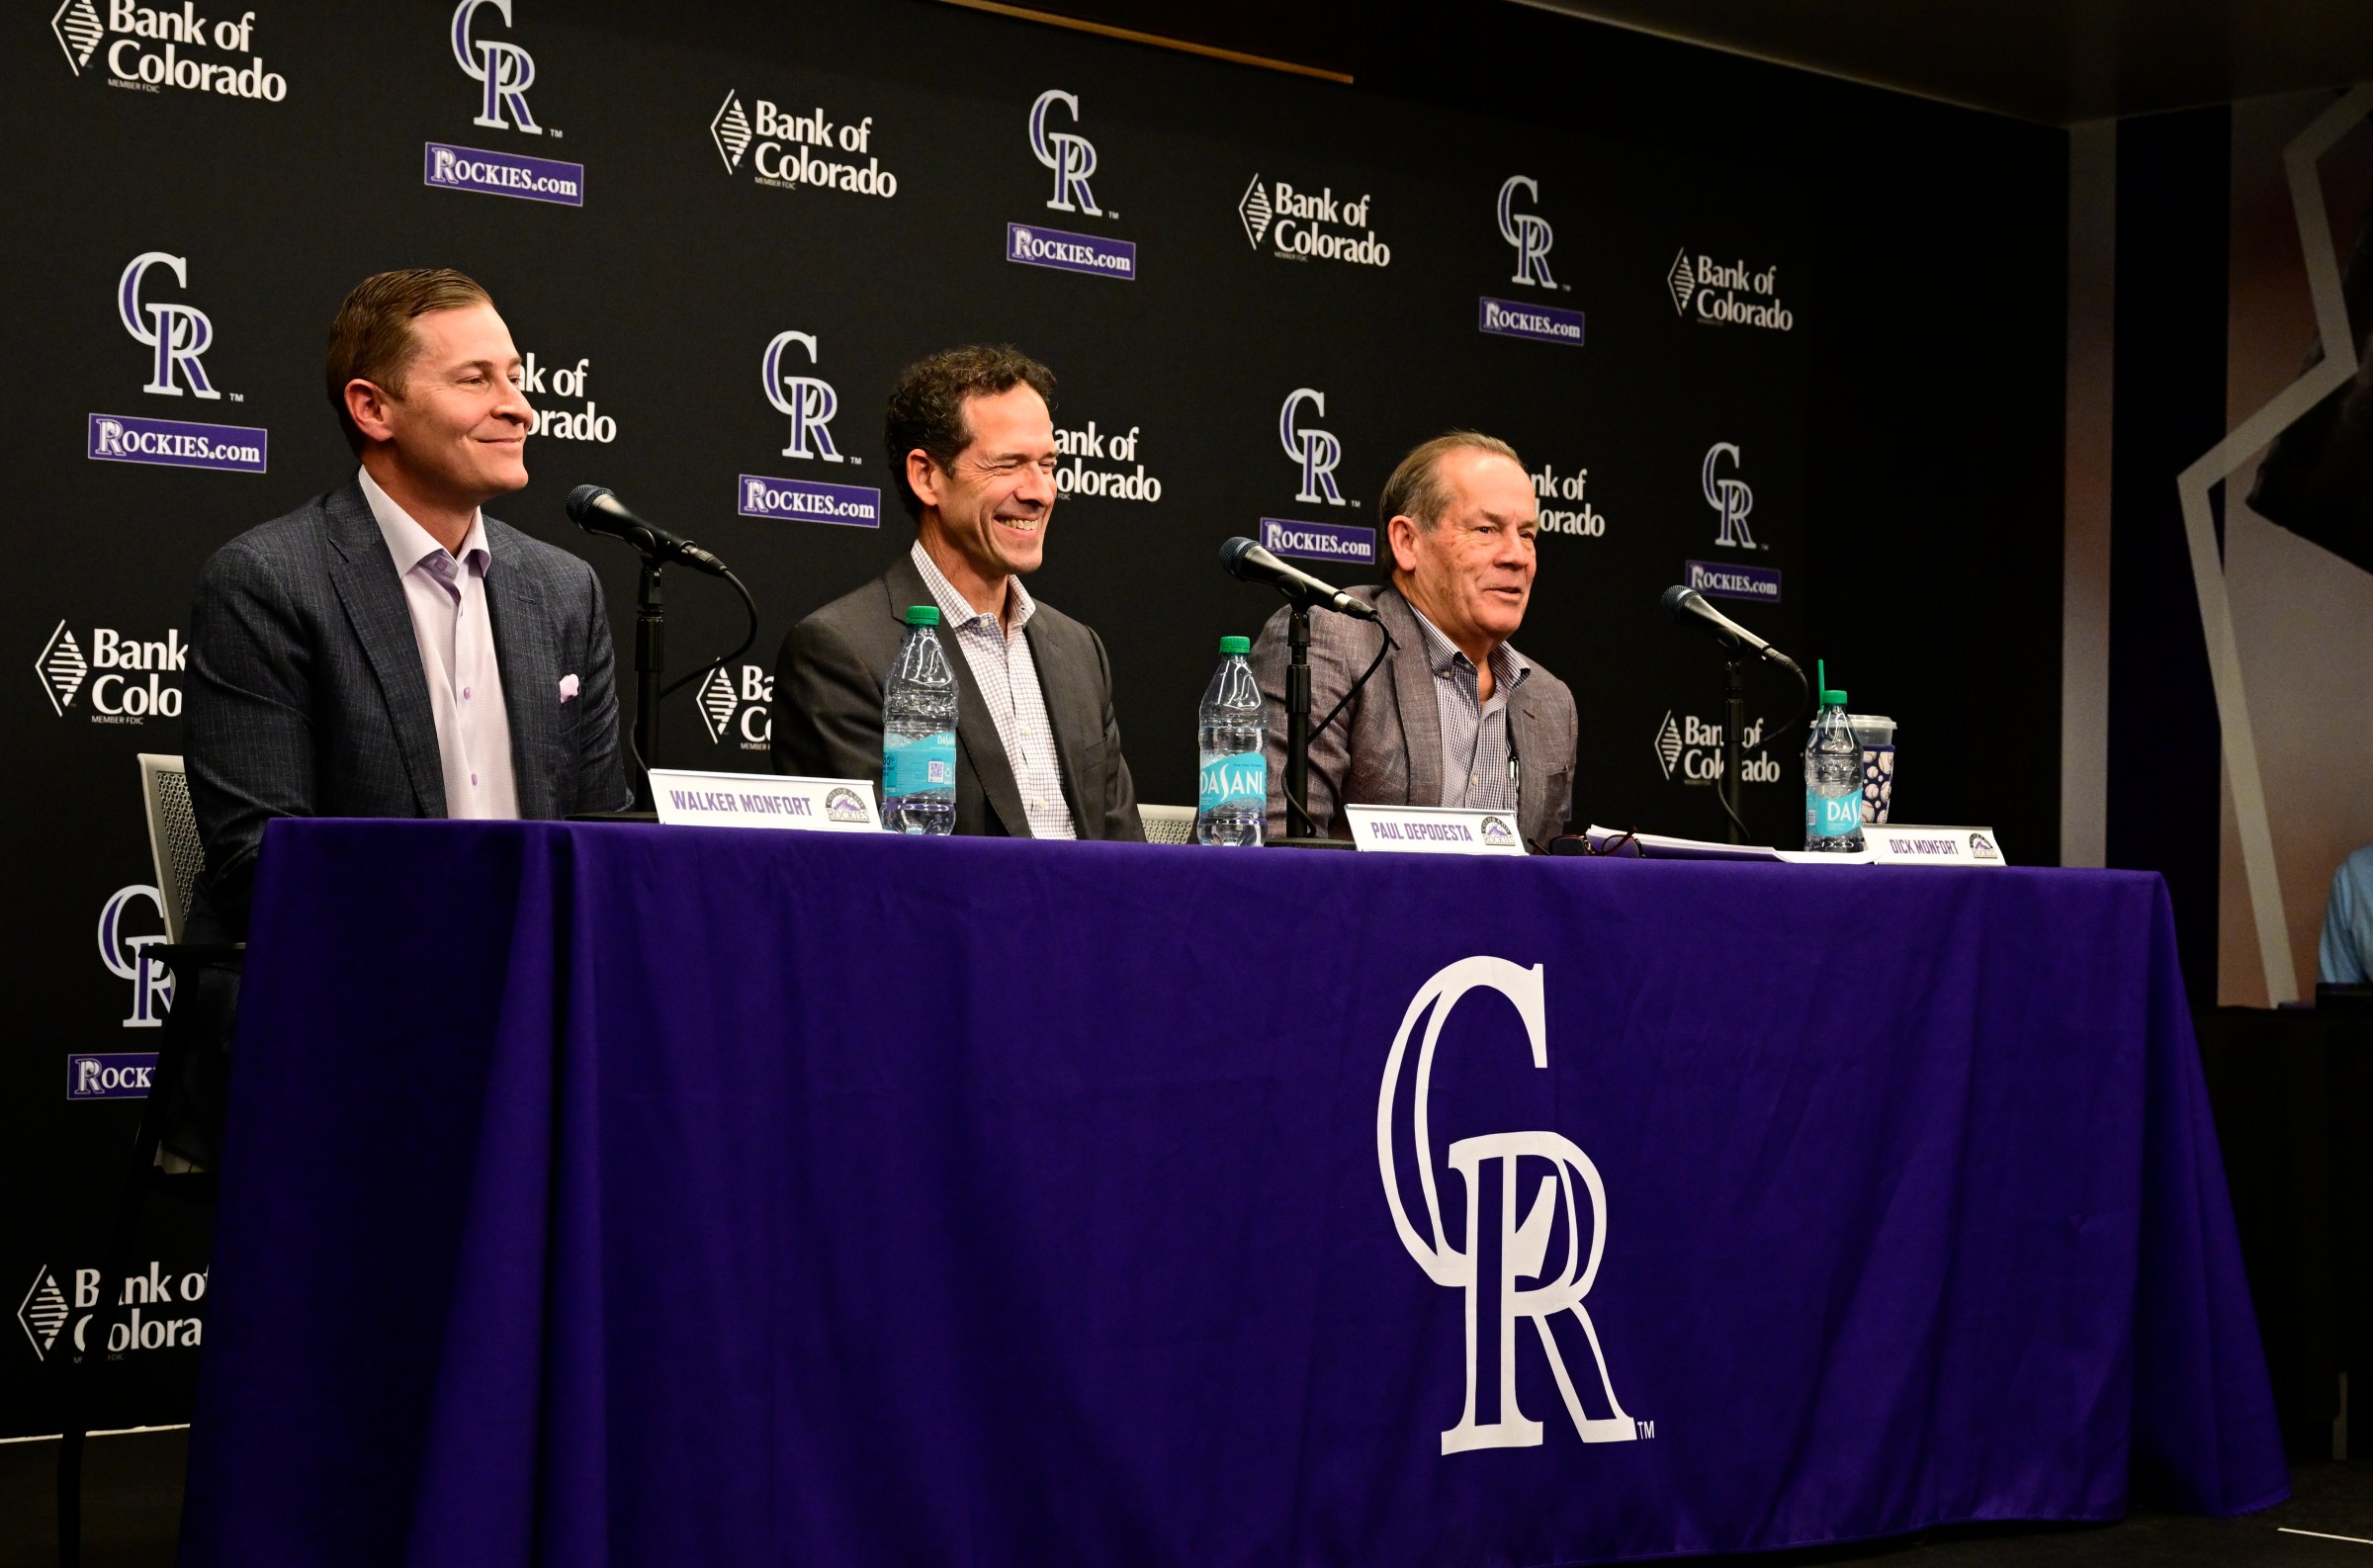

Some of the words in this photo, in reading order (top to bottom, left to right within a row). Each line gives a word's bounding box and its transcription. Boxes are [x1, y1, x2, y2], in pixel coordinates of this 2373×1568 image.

[110, 0, 207, 45] Bank
[214, 12, 256, 52] of
[108, 40, 287, 102] Colorado
[108, 78, 141, 91] MEMBER
[141, 82, 160, 94] FDIC
[755, 100, 834, 147] Bank
[838, 117, 872, 153] of
[754, 141, 898, 198] Colorado
[1274, 182, 1339, 222] Bank
[1343, 195, 1370, 227] of
[1274, 218, 1391, 267] Colorado
[1698, 255, 1750, 292] Bank
[1754, 265, 1777, 296] of
[1697, 290, 1794, 331] Colorado
[552, 359, 589, 397] of
[1051, 420, 1104, 458] ank
[1109, 426, 1139, 462] of
[1054, 457, 1162, 502] olorado
[1531, 464, 1559, 497] nk
[1562, 469, 1588, 500] of
[92, 673, 182, 717] Colo
[1685, 715, 1724, 746] Ban
[1199, 763, 1264, 802] DASANI
[1684, 748, 1780, 782] Colado
[669, 790, 739, 812] WALKER
[739, 794, 812, 816] MONFORT
[1370, 823, 1404, 839] PAUL
[1403, 823, 1473, 841] DEPODESTA
[1889, 839, 1915, 854] DICK
[1913, 839, 1959, 854] MONFORT
[75, 1261, 172, 1308] Bnk
